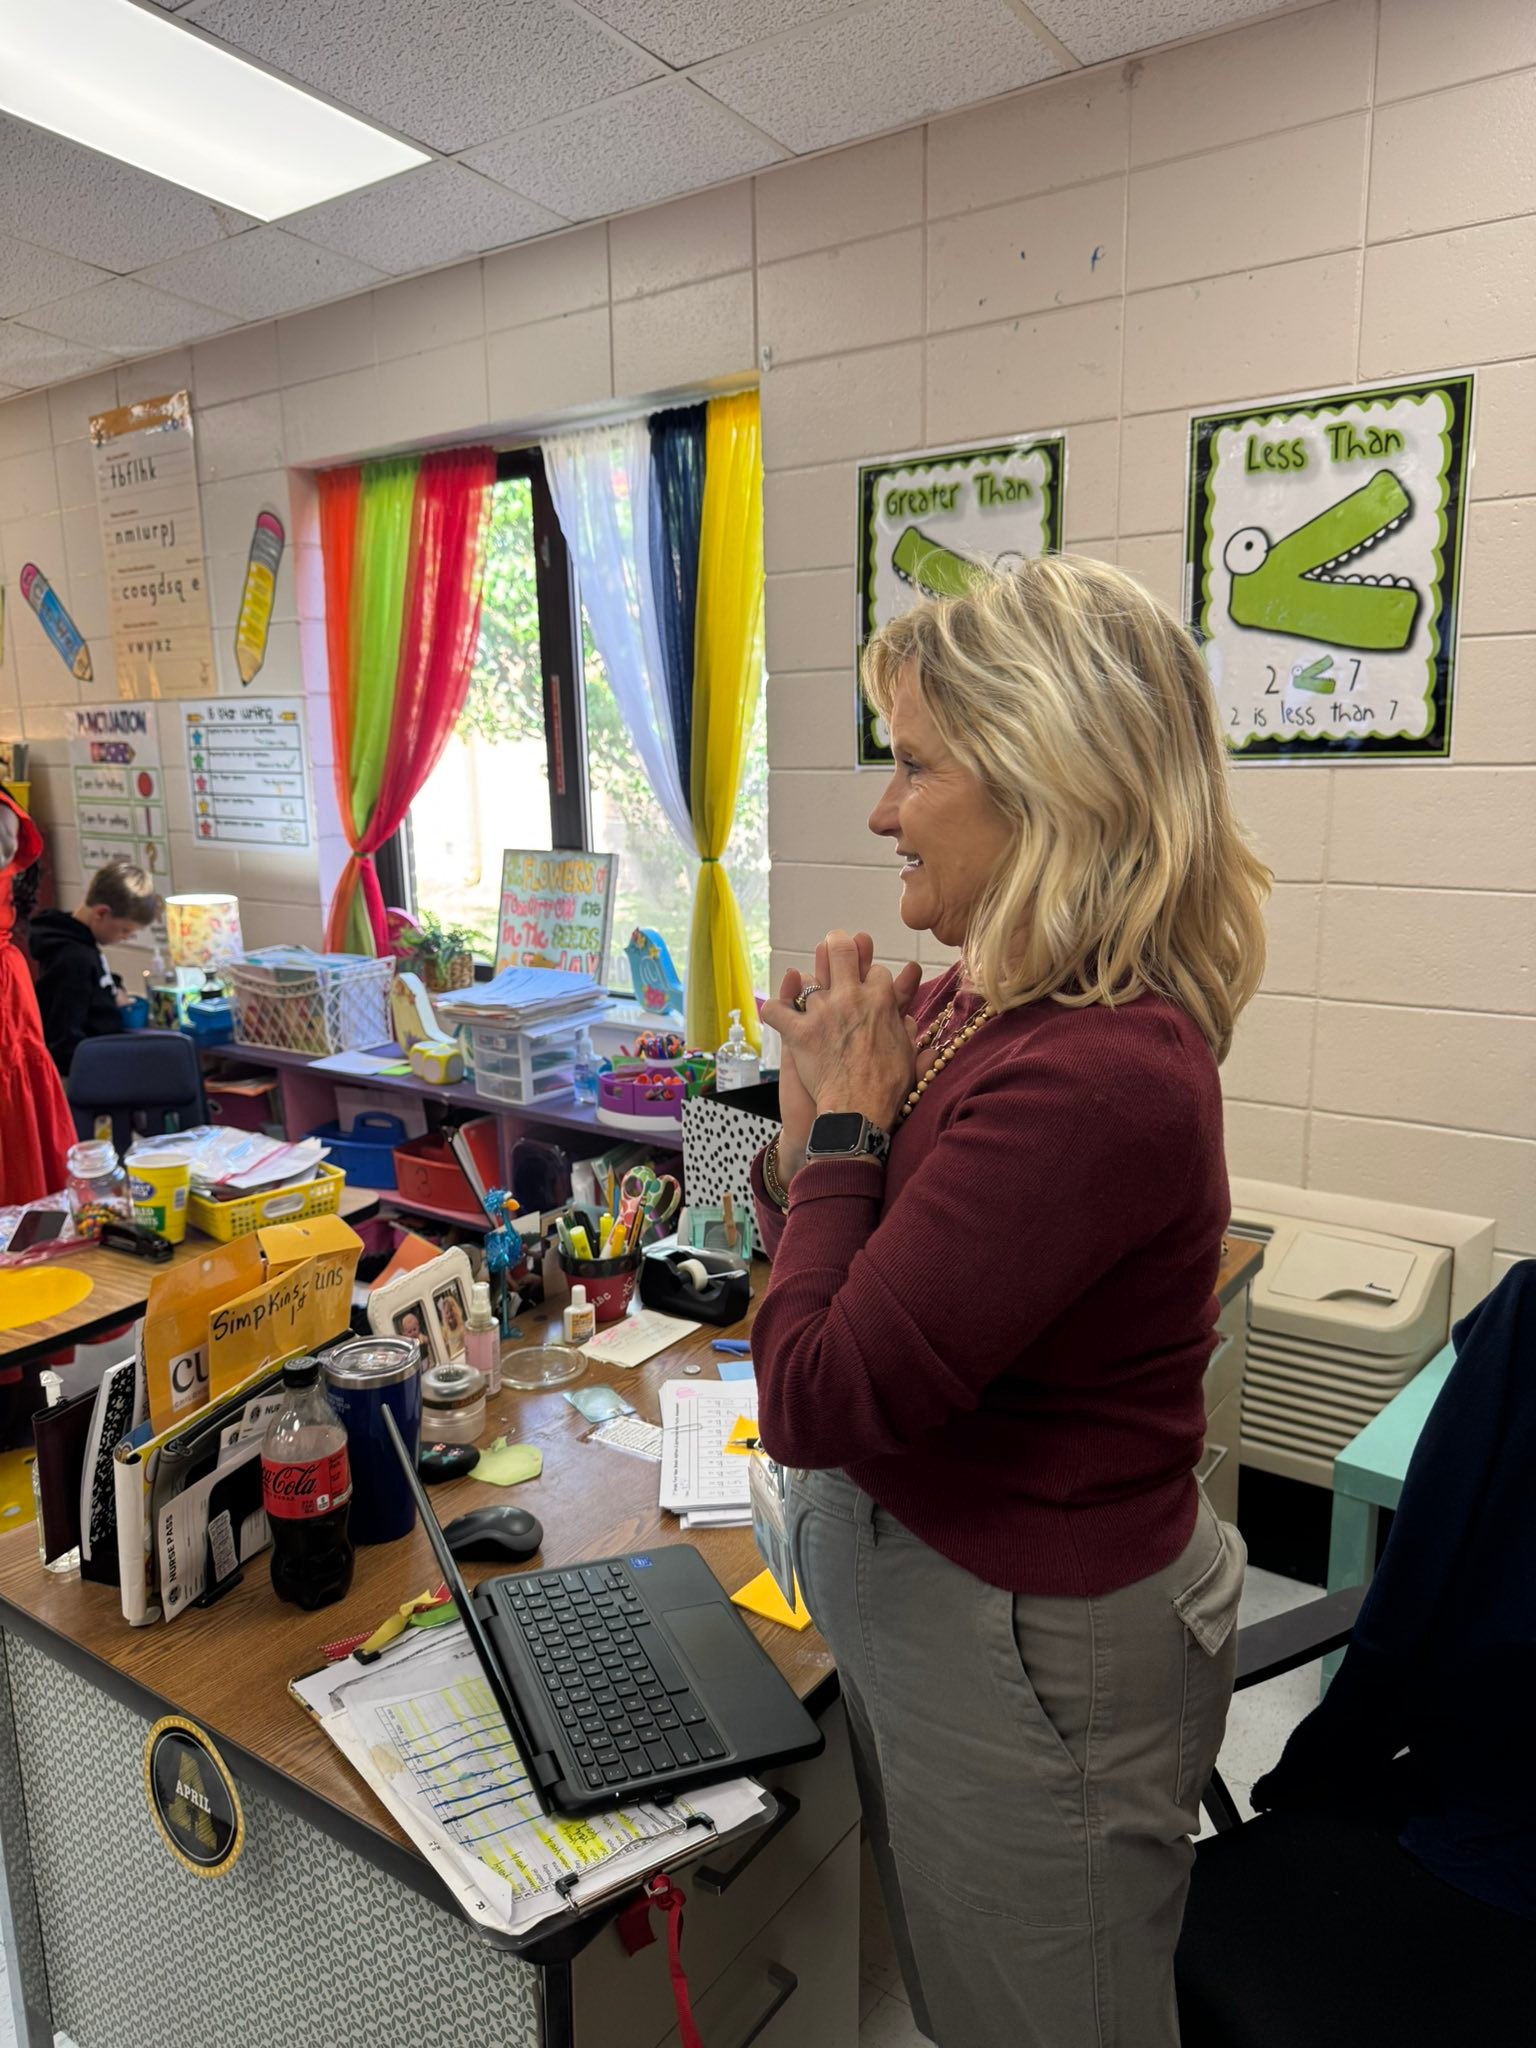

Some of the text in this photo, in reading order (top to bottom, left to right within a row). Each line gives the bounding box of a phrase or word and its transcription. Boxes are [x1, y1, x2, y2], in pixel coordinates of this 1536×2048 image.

[1248, 425, 1402, 474] Less Than
[885, 473, 1032, 516] Greater Than
[1264, 658, 1361, 695] 2 7
[1230, 699, 1399, 727] 2 is less than 7
[522, 856, 595, 895] FLOWERS
[165, 1514, 178, 1583] NURSE PASS
[175, 1779, 212, 1815] APRIL
[476, 1901, 486, 1911] R
